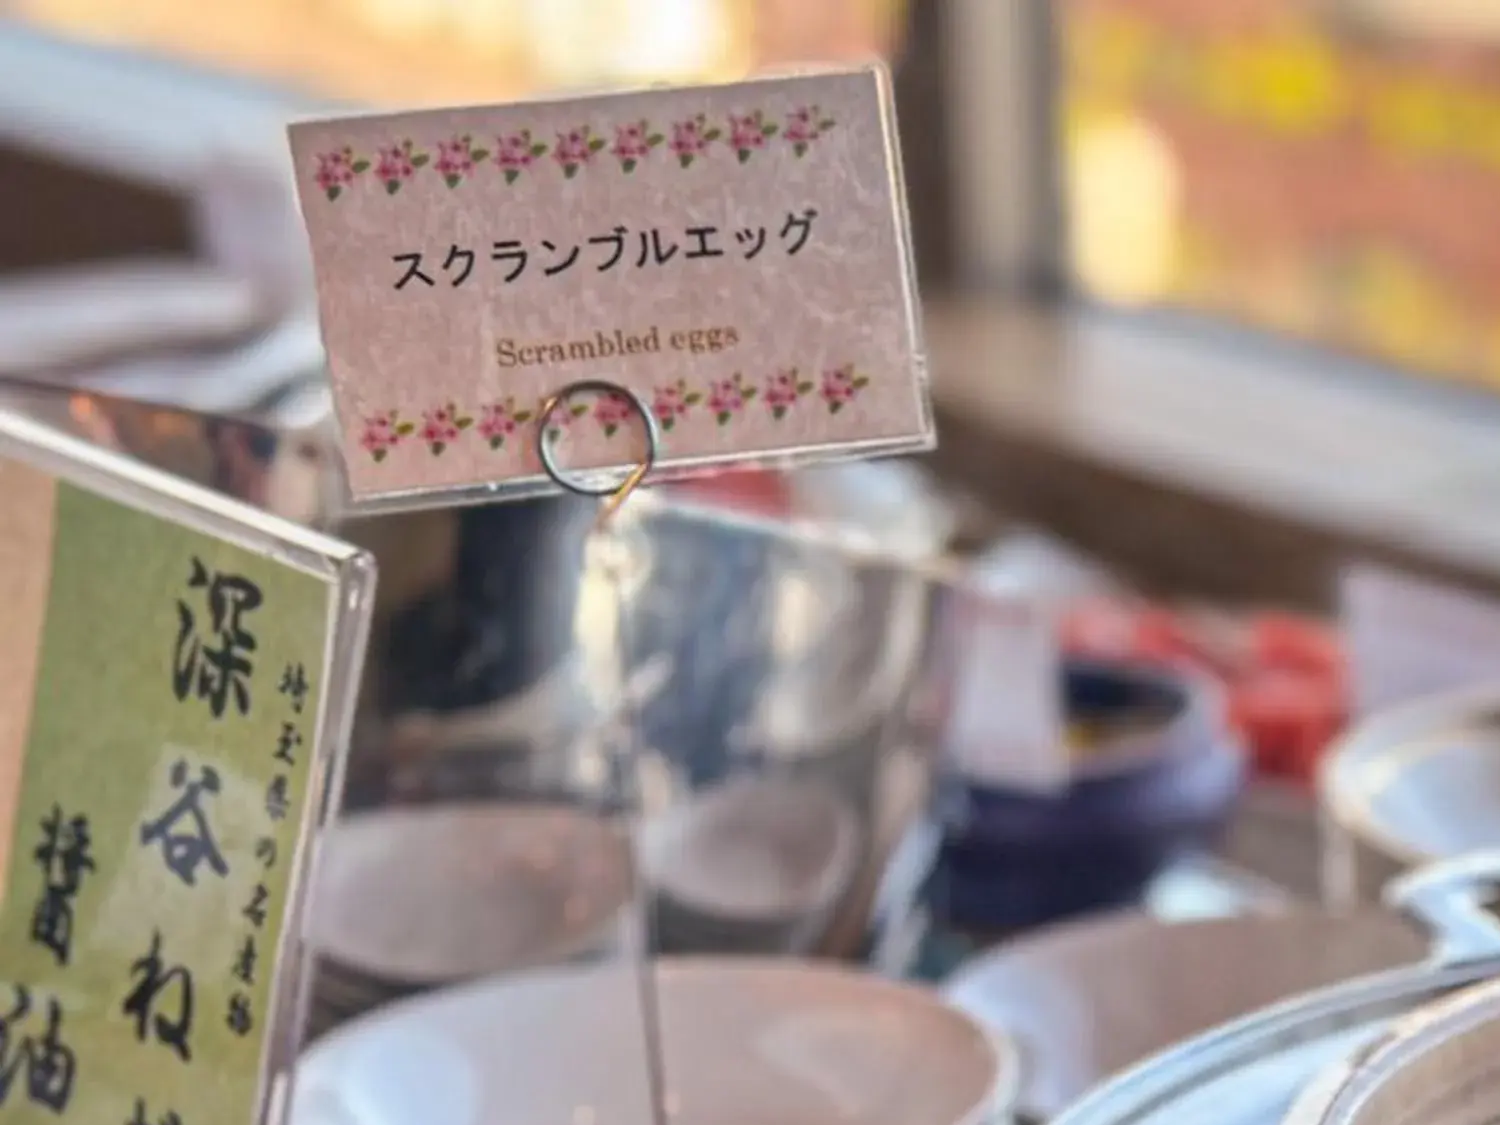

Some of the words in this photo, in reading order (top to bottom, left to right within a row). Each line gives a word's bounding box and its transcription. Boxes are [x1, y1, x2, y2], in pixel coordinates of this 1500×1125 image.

[391, 208, 818, 290] スクランブルエッグ
[496, 326, 661, 367] Scrambled
[669, 326, 740, 354] eggs
